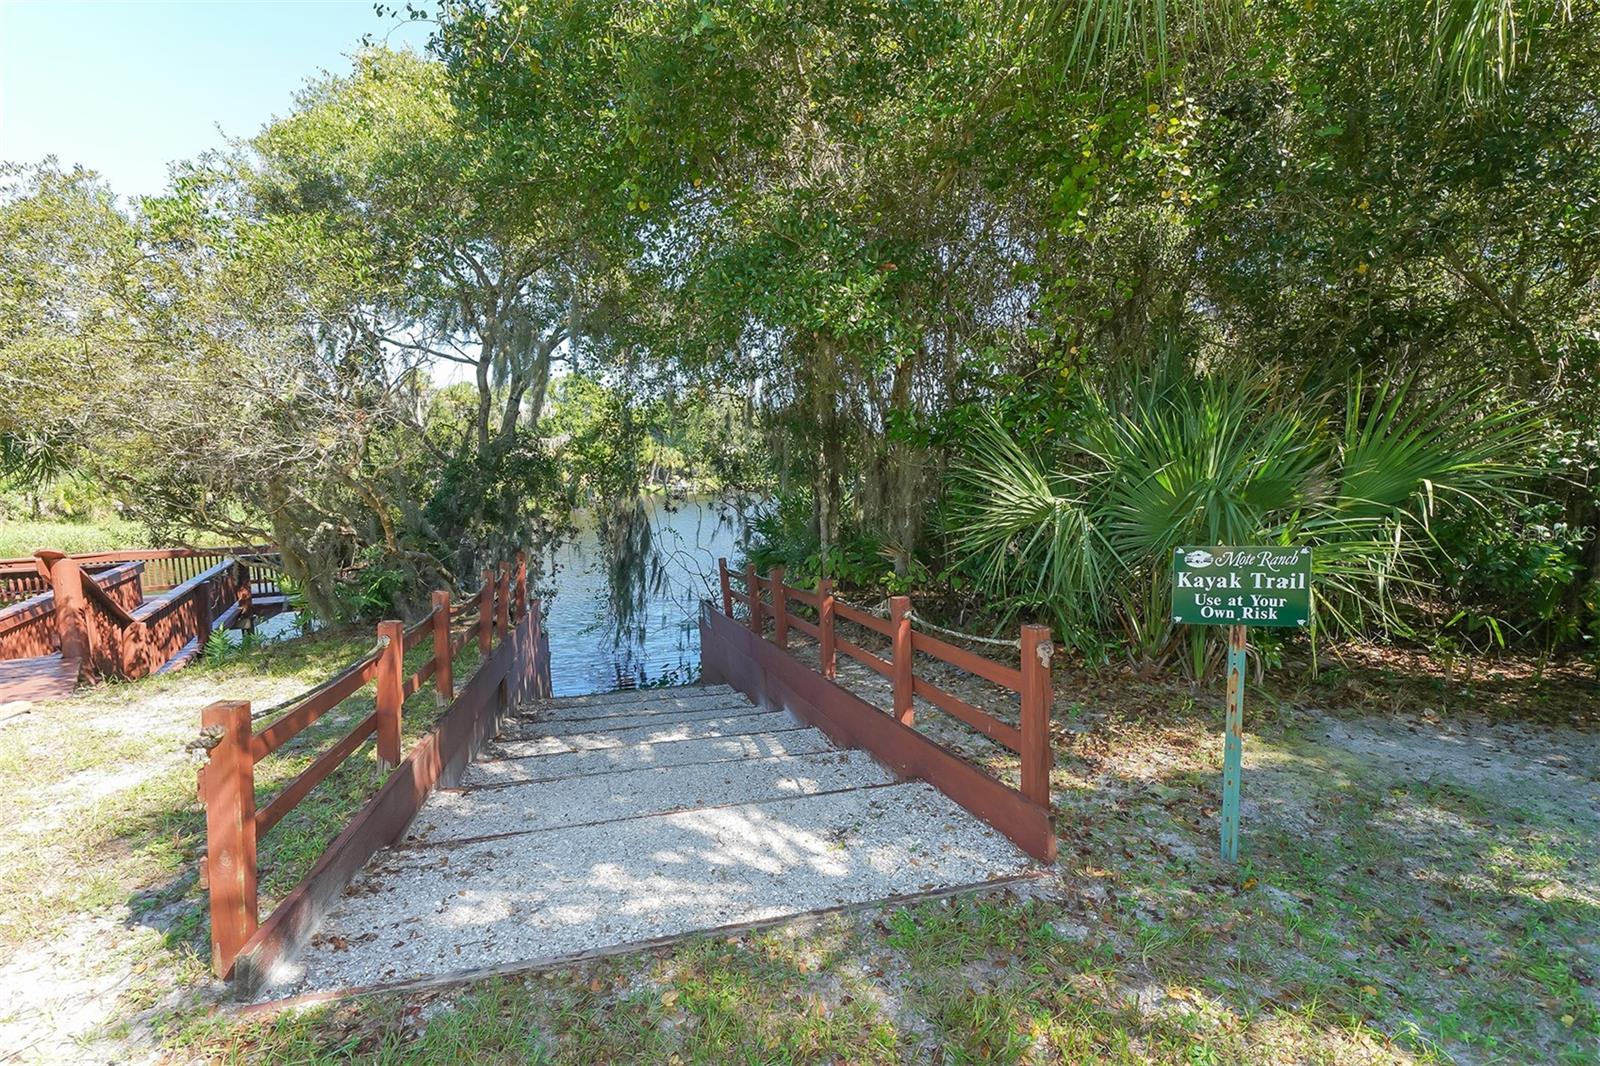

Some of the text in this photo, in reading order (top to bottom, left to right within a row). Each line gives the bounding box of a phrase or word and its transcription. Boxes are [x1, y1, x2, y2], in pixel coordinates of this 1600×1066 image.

[1215, 551, 1299, 572] Mote Ranch
[1177, 572, 1305, 591] Kayak Trail
[1194, 593, 1288, 607] Use at Your
[1200, 606, 1278, 620] Own Risk
